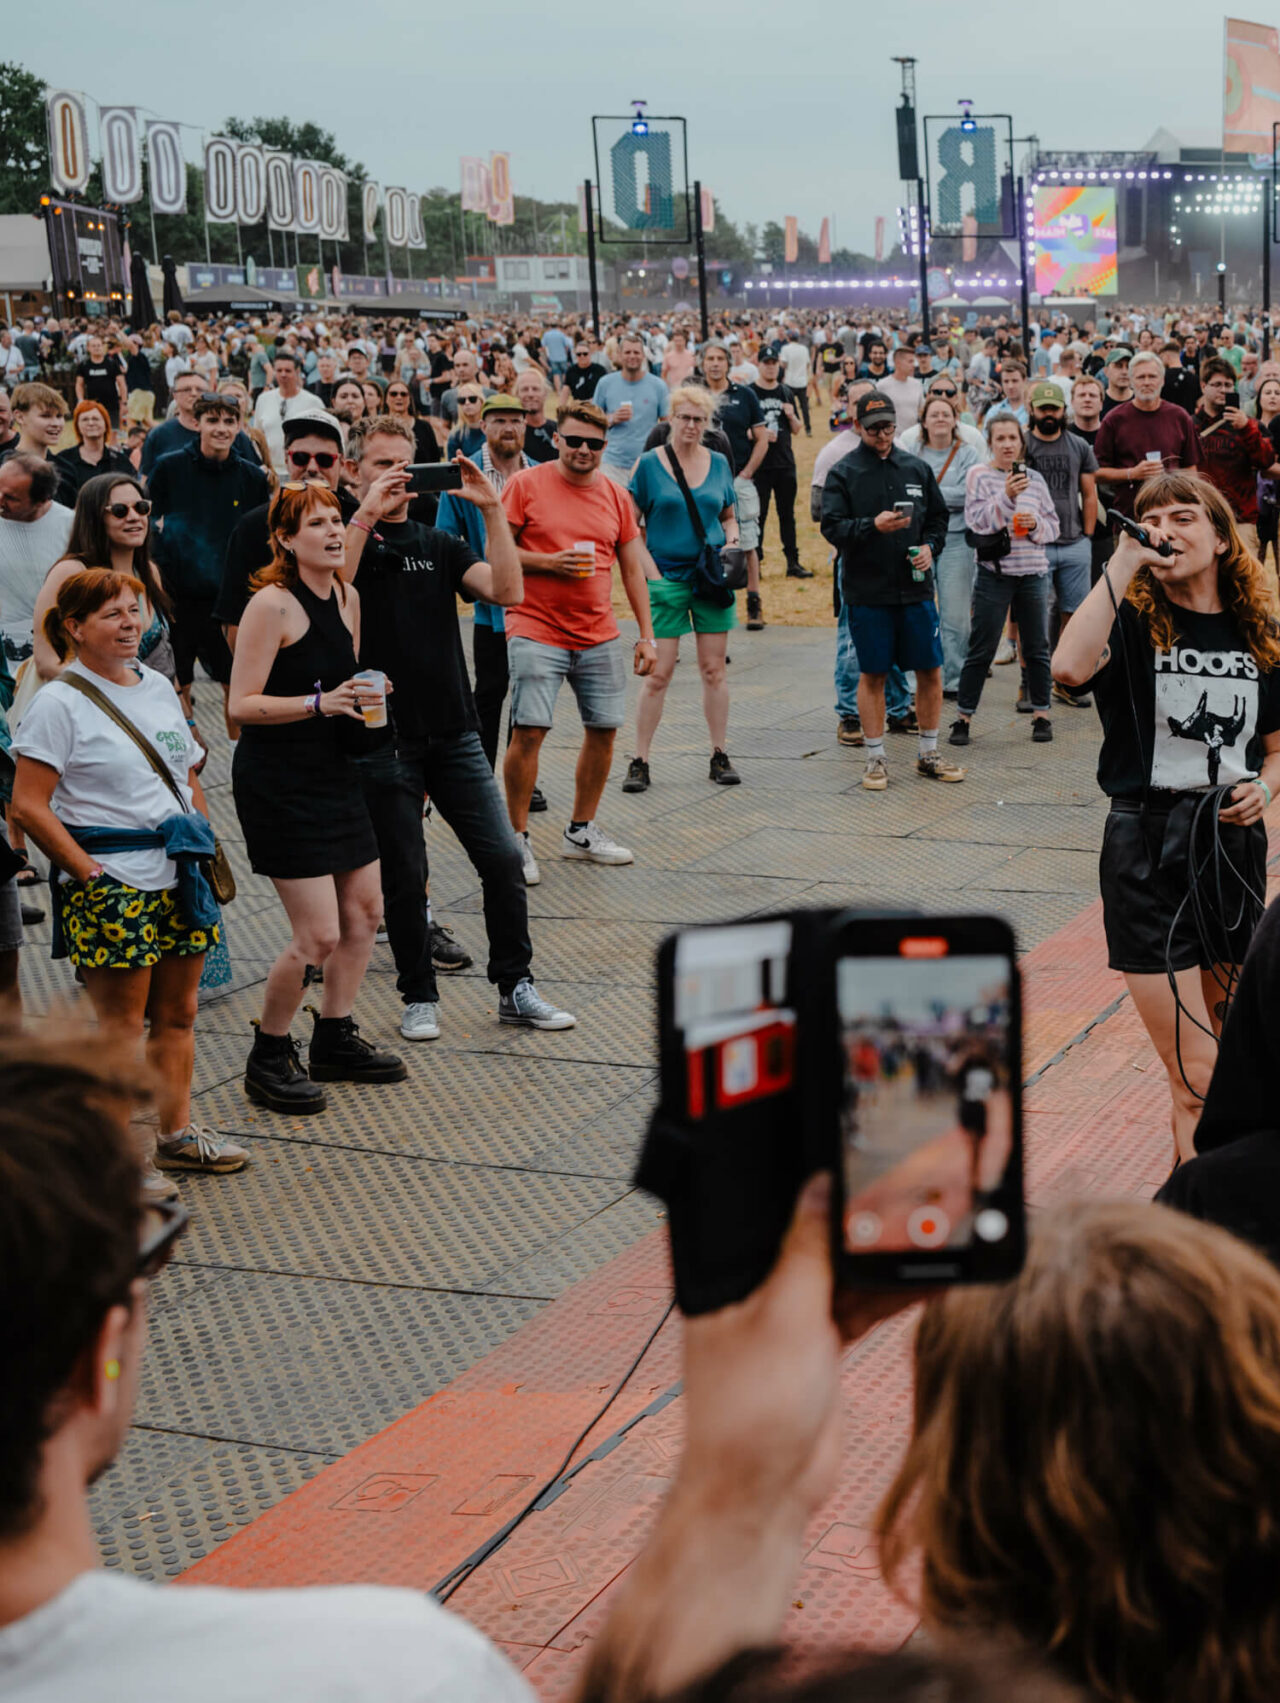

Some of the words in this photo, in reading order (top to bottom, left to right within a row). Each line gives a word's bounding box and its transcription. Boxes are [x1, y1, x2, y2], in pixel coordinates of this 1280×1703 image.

[1043, 471, 1067, 490] TOP
[403, 556, 435, 571] live
[1154, 645, 1259, 679] HOOFS
